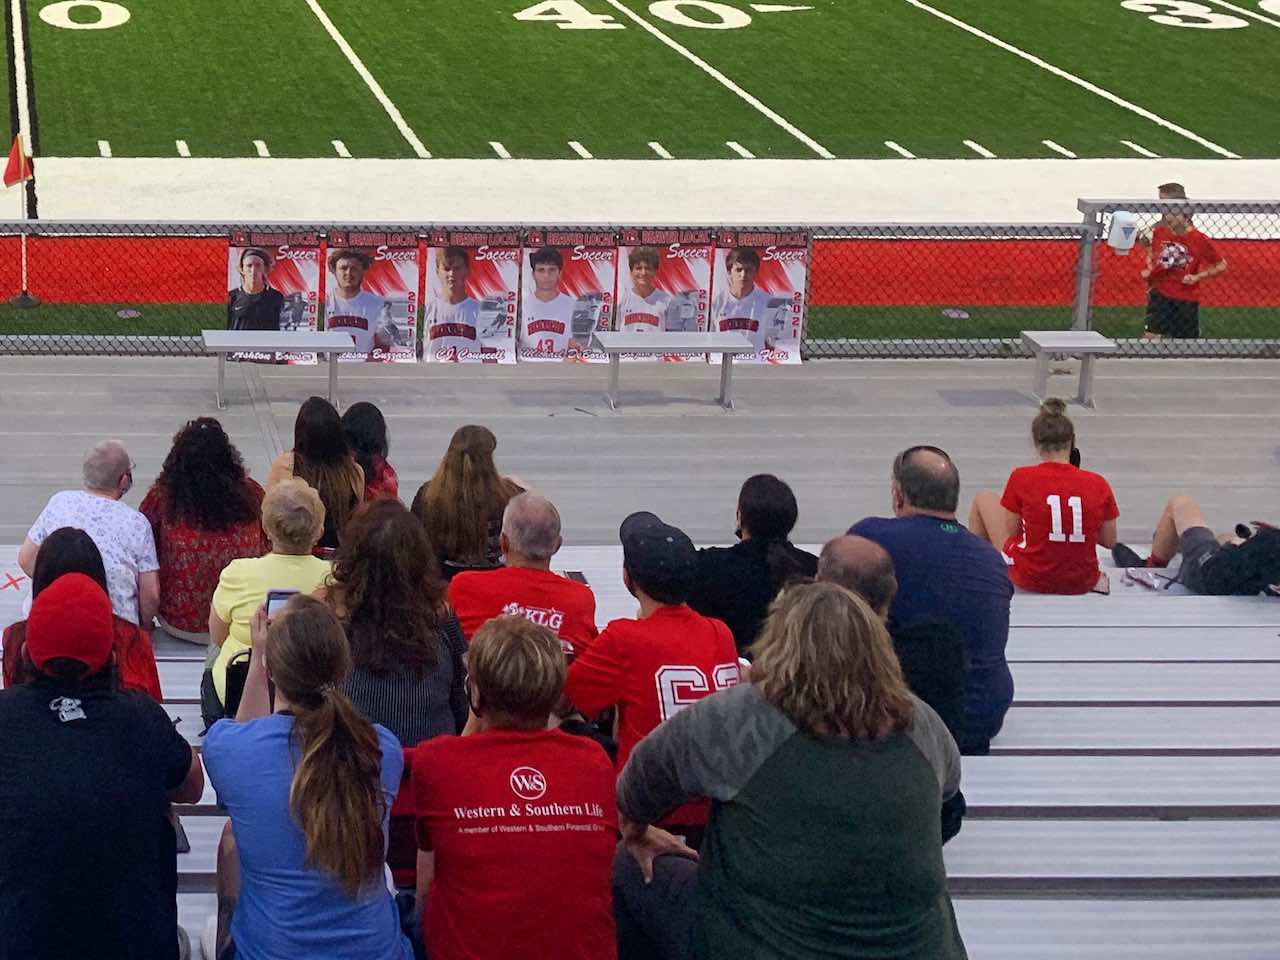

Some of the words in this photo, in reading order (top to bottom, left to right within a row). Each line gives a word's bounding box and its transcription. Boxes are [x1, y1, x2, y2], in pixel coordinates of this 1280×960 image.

[512, 0, 752, 30] 40
[276, 245, 317, 260] Soccer
[374, 245, 416, 260] Soccer
[475, 245, 517, 260] Soccer
[571, 245, 612, 260] Soccer
[666, 243, 708, 259] Soccer
[763, 245, 804, 260] Soccer
[407, 291, 416, 338] 2021
[507, 291, 516, 338] 2021
[791, 292, 801, 338] 2021
[435, 348, 458, 360] CJ
[1046, 494, 1086, 542] 11
[655, 662, 740, 721] 6
[453, 805, 505, 819] Western
[510, 803, 521, 817] &
[525, 802, 582, 817] Southern
[585, 803, 603, 817] Life
[464, 826, 490, 834] member
[491, 825, 498, 833] of
[499, 825, 527, 833] Western
[535, 824, 565, 832] Southern
[566, 823, 591, 831] Financial
